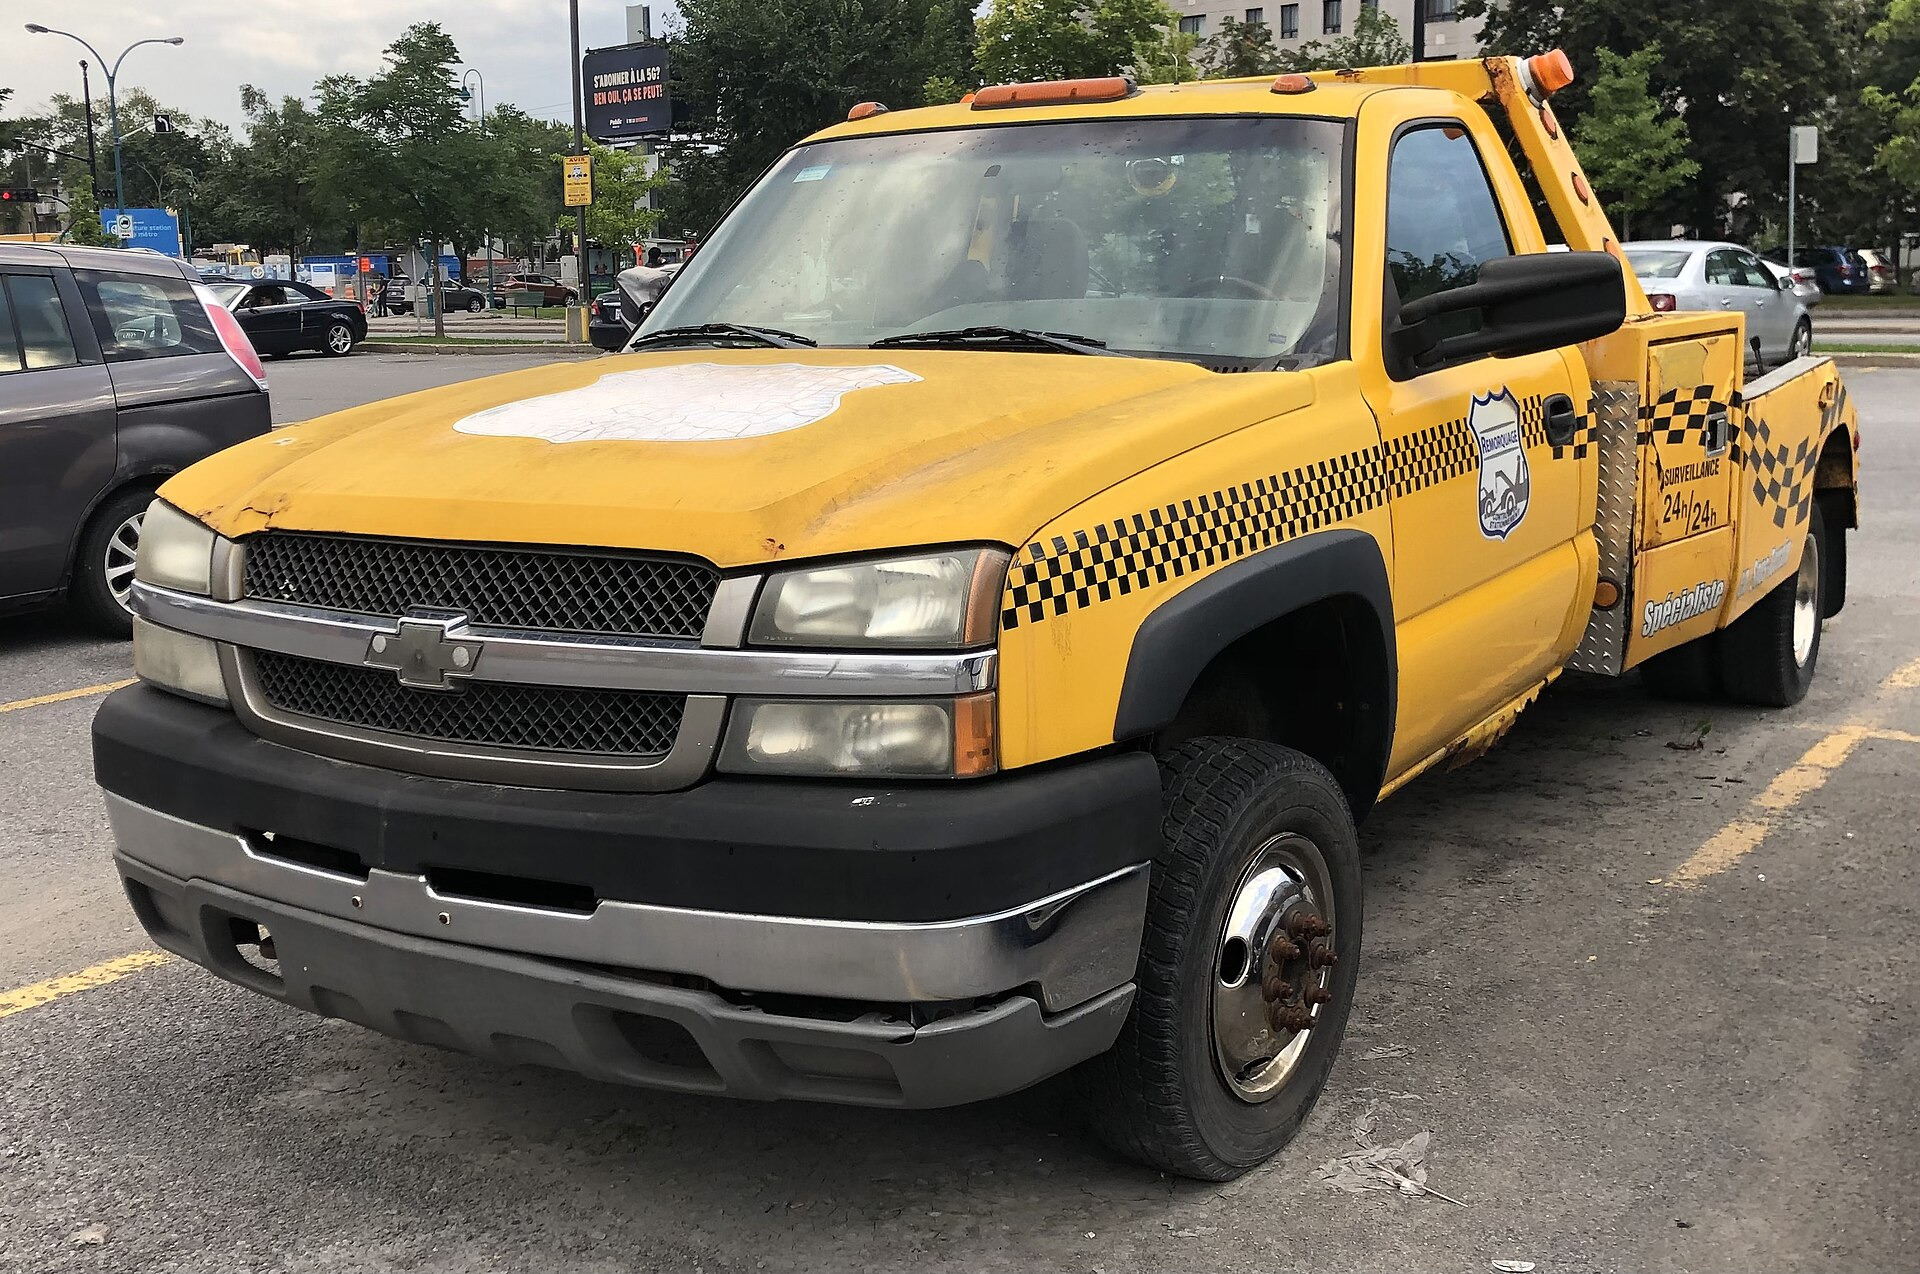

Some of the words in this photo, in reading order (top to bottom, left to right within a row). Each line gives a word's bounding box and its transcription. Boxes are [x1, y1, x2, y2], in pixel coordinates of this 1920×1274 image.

[593, 71, 630, 88] S'ABONNER
[630, 67, 636, 84] À
[636, 69, 646, 82] LA
[646, 66, 661, 82] 5G?
[593, 91, 607, 106] BEN
[607, 90, 622, 104] OUI,
[622, 88, 633, 105] ÇA
[633, 87, 642, 101] SE
[642, 84, 663, 100] PEUT!
[609, 118, 622, 126] Public
[1481, 430, 1518, 454] REMORQUAGE
[1664, 458, 1720, 486] SURVEILLANCE
[1663, 489, 1717, 535] 24h/24h
[1641, 579, 1725, 638] Spécialiste
